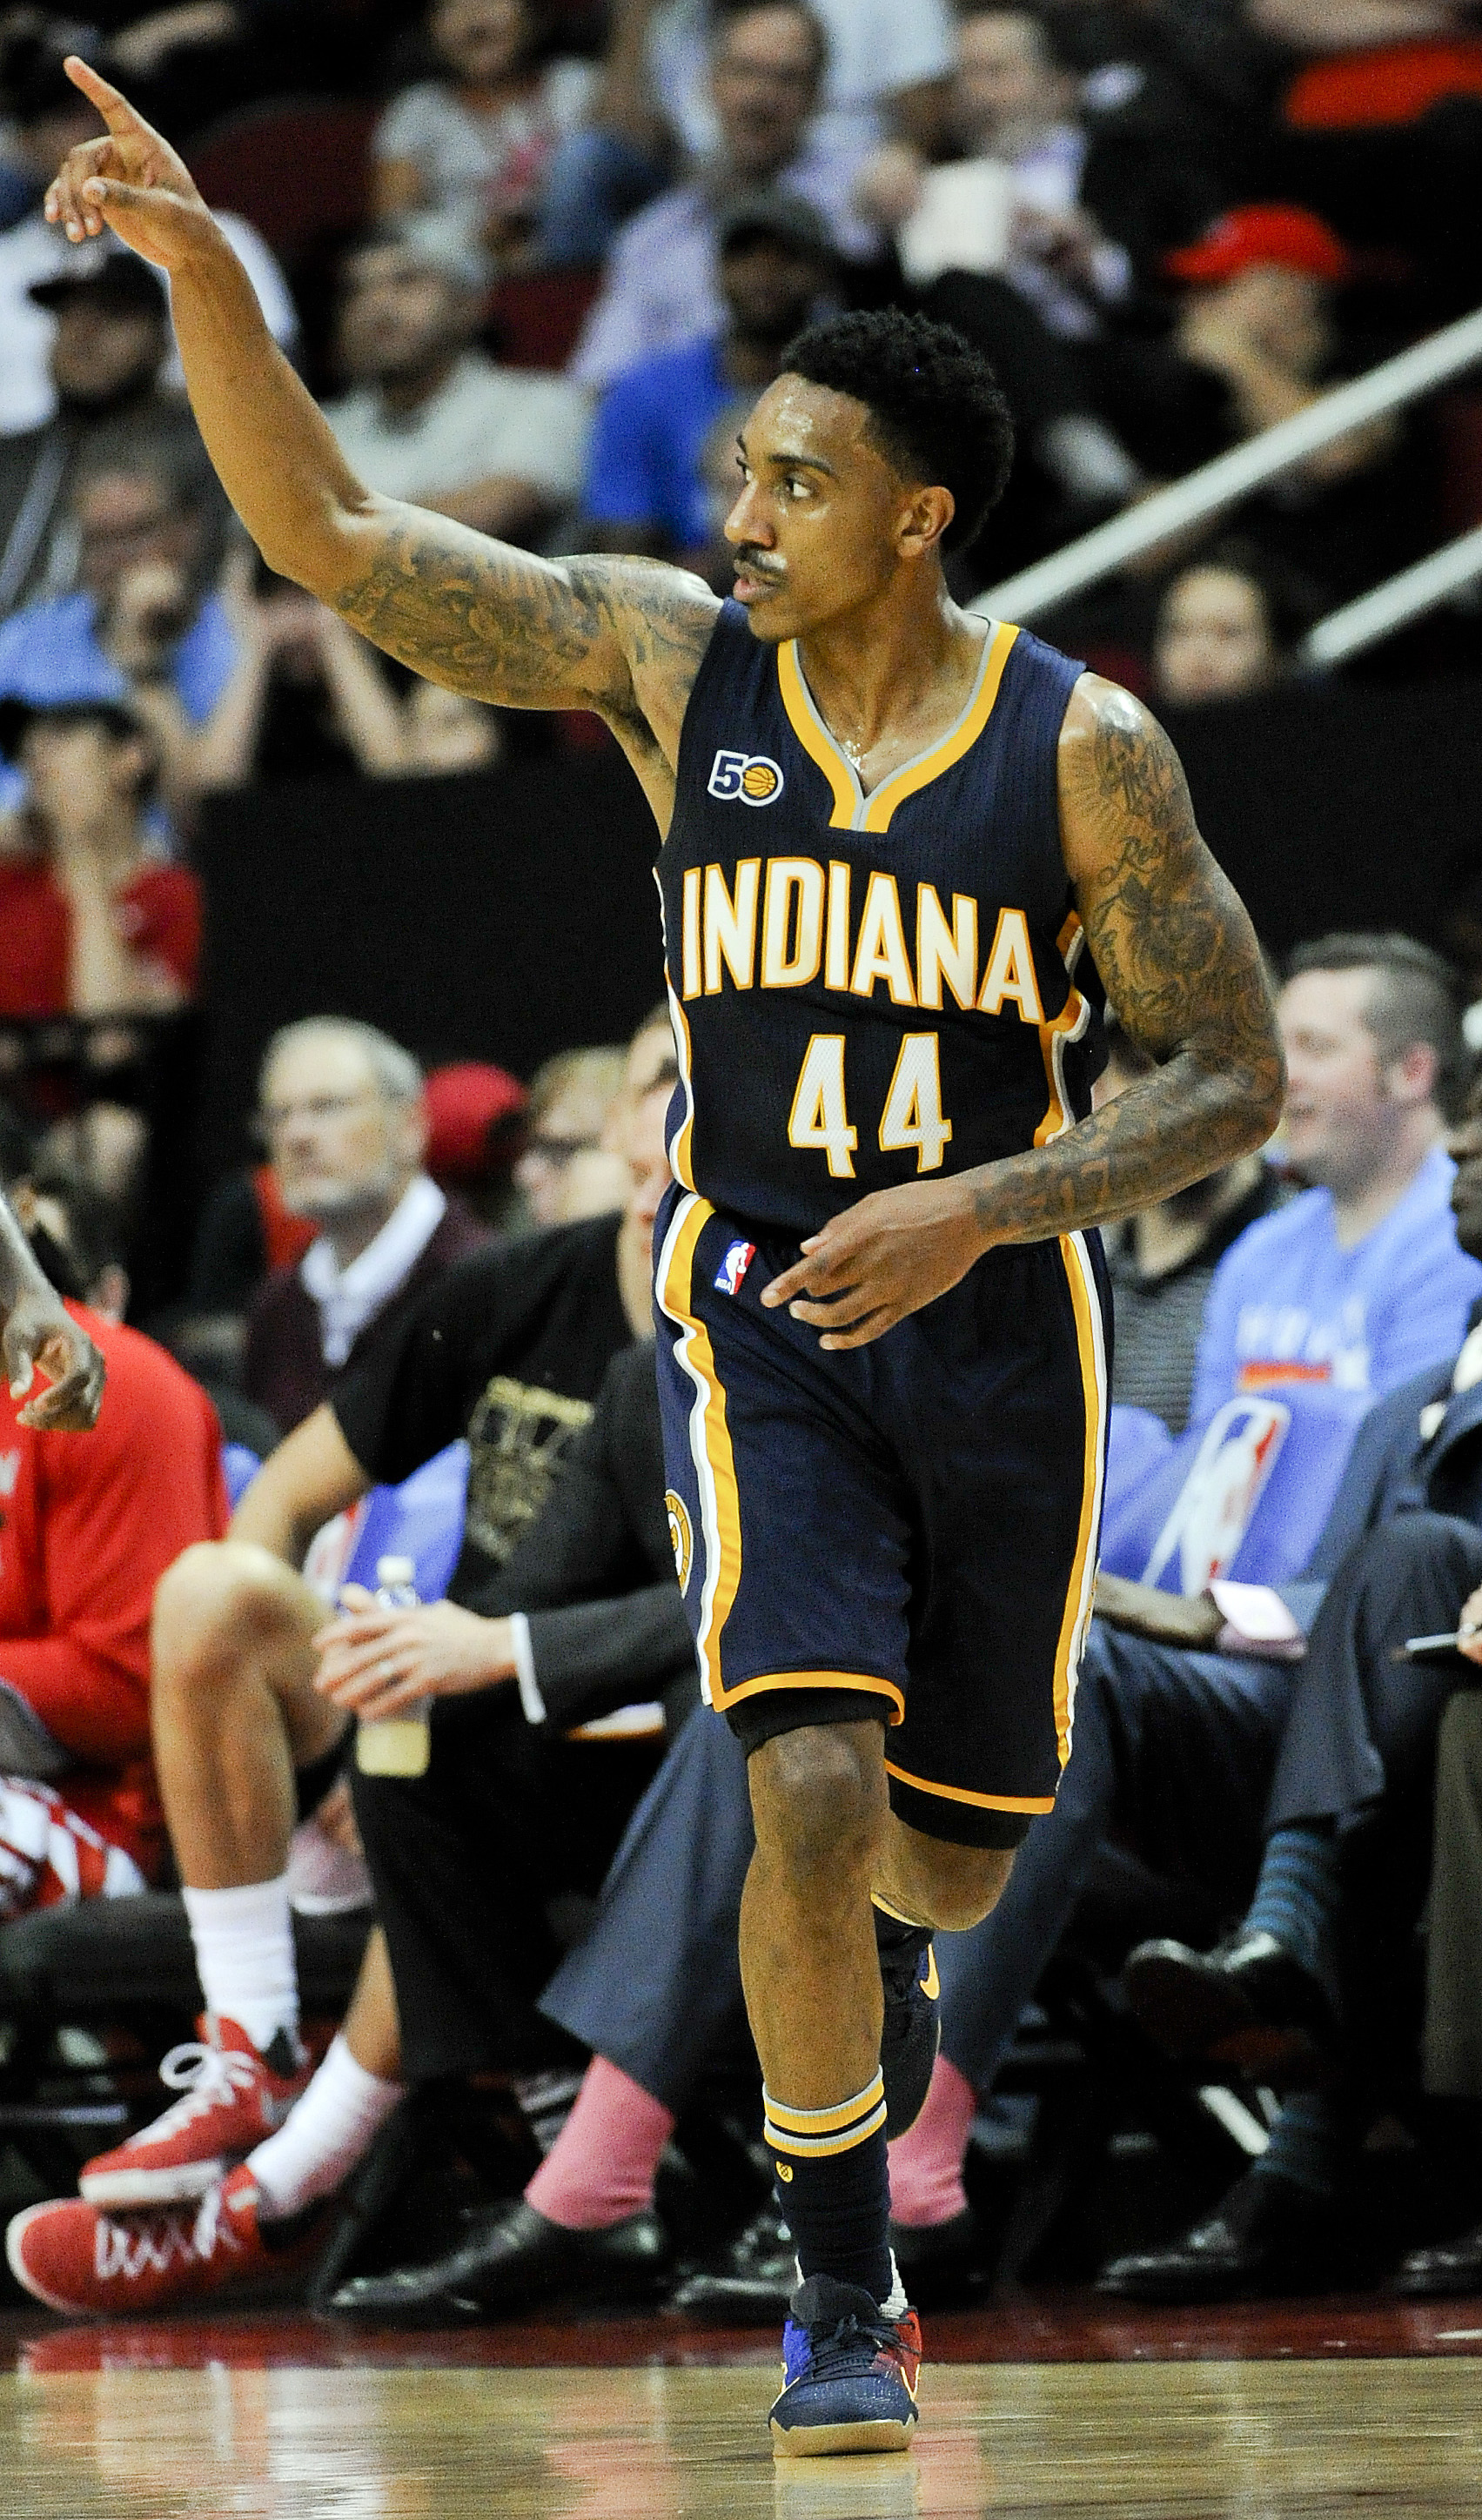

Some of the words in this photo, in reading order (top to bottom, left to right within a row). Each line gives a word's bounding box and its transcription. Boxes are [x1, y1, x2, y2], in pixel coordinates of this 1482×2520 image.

[707, 750, 783, 807] 50
[683, 857, 1045, 1025] INDIANA
[788, 1033, 952, 1178] 44
